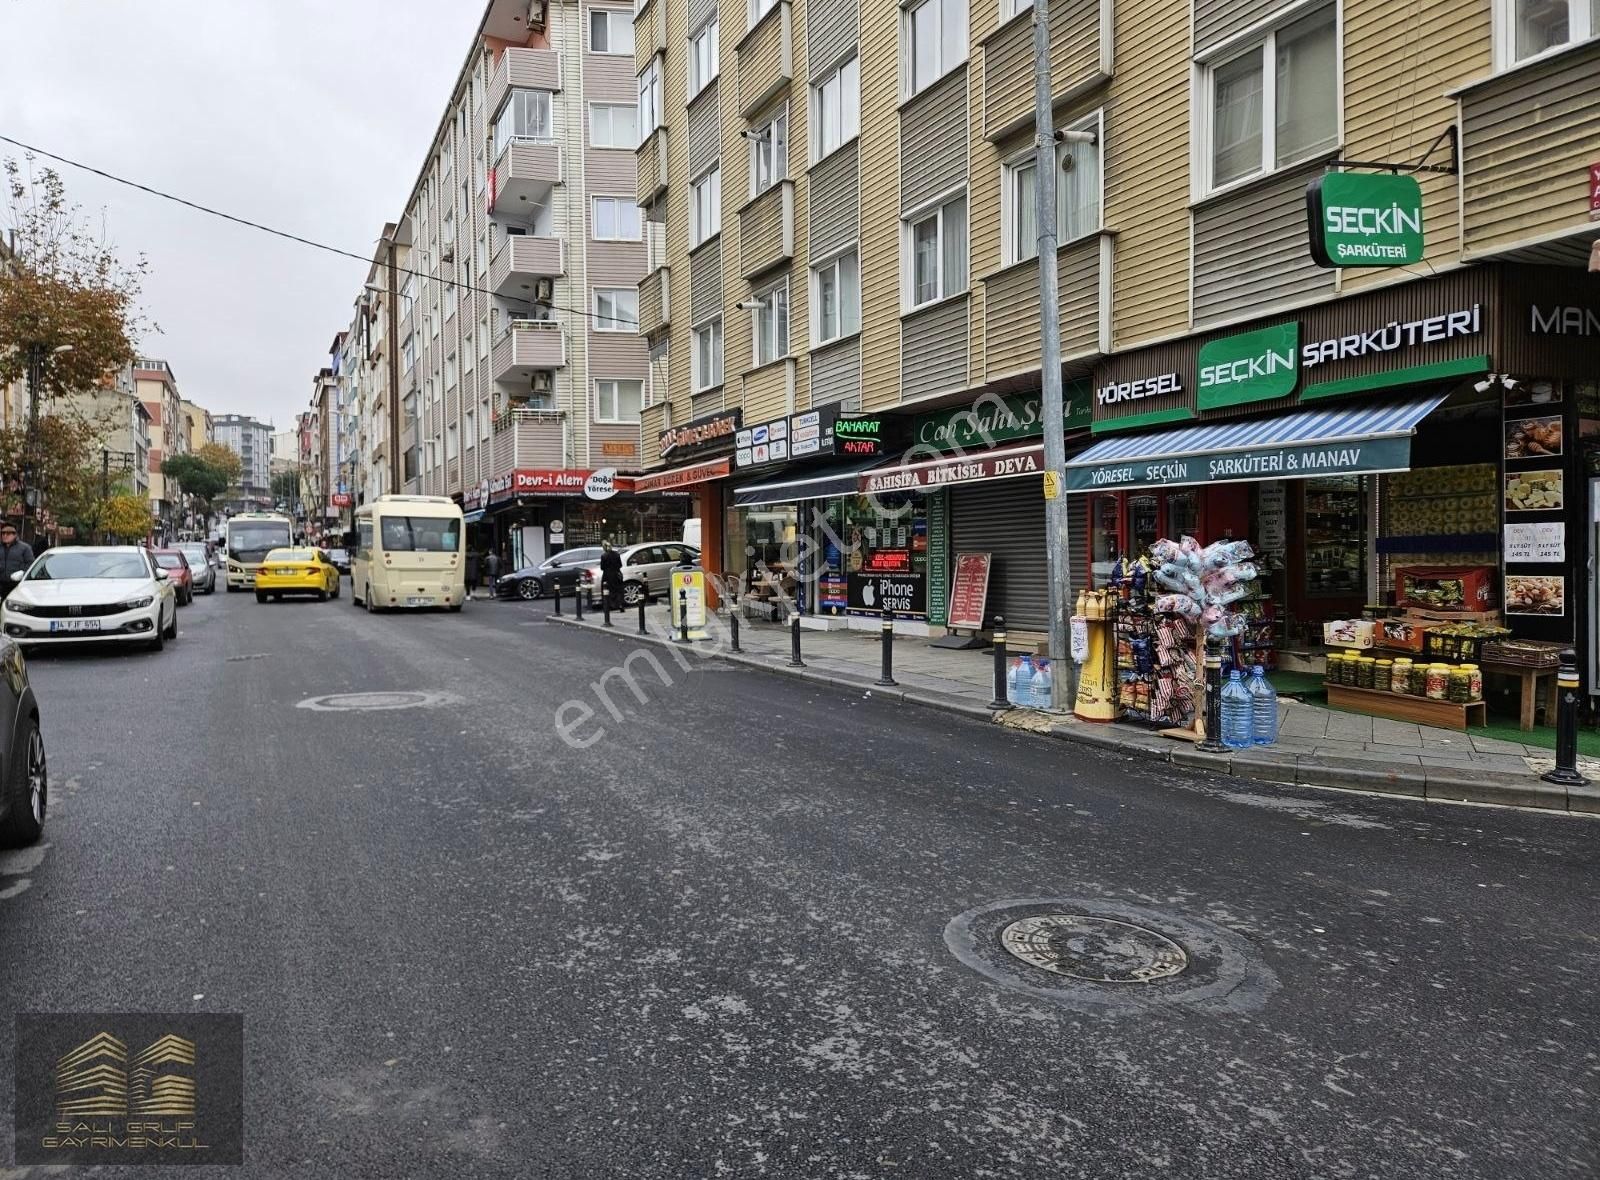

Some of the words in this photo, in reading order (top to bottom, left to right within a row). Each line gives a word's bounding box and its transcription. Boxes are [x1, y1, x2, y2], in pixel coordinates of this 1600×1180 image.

[1326, 202, 1420, 236] SEÇKİN
[1337, 243, 1407, 258] ŞARKÜTERİ
[1302, 304, 1481, 368] ŞARKÜTERİ
[1200, 348, 1294, 388] SEÇKİN
[1096, 373, 1182, 405] YÖRESEL
[836, 421, 880, 433] BAHARAT
[845, 442, 873, 452] AKTAR
[927, 463, 985, 485] BİTKİSEL
[995, 455, 1037, 475] DEVA
[1091, 467, 1134, 485] YÖRESEL
[1146, 460, 1187, 483] SEÇKİN
[1209, 454, 1283, 480] ŞARKÜTERİ
[1287, 453, 1299, 470] &
[1301, 448, 1361, 470] MANAV
[518, 473, 553, 486] Devr-i
[555, 473, 583, 486] Alem
[593, 476, 612, 485] Doğa
[879, 579, 914, 597] iPhone
